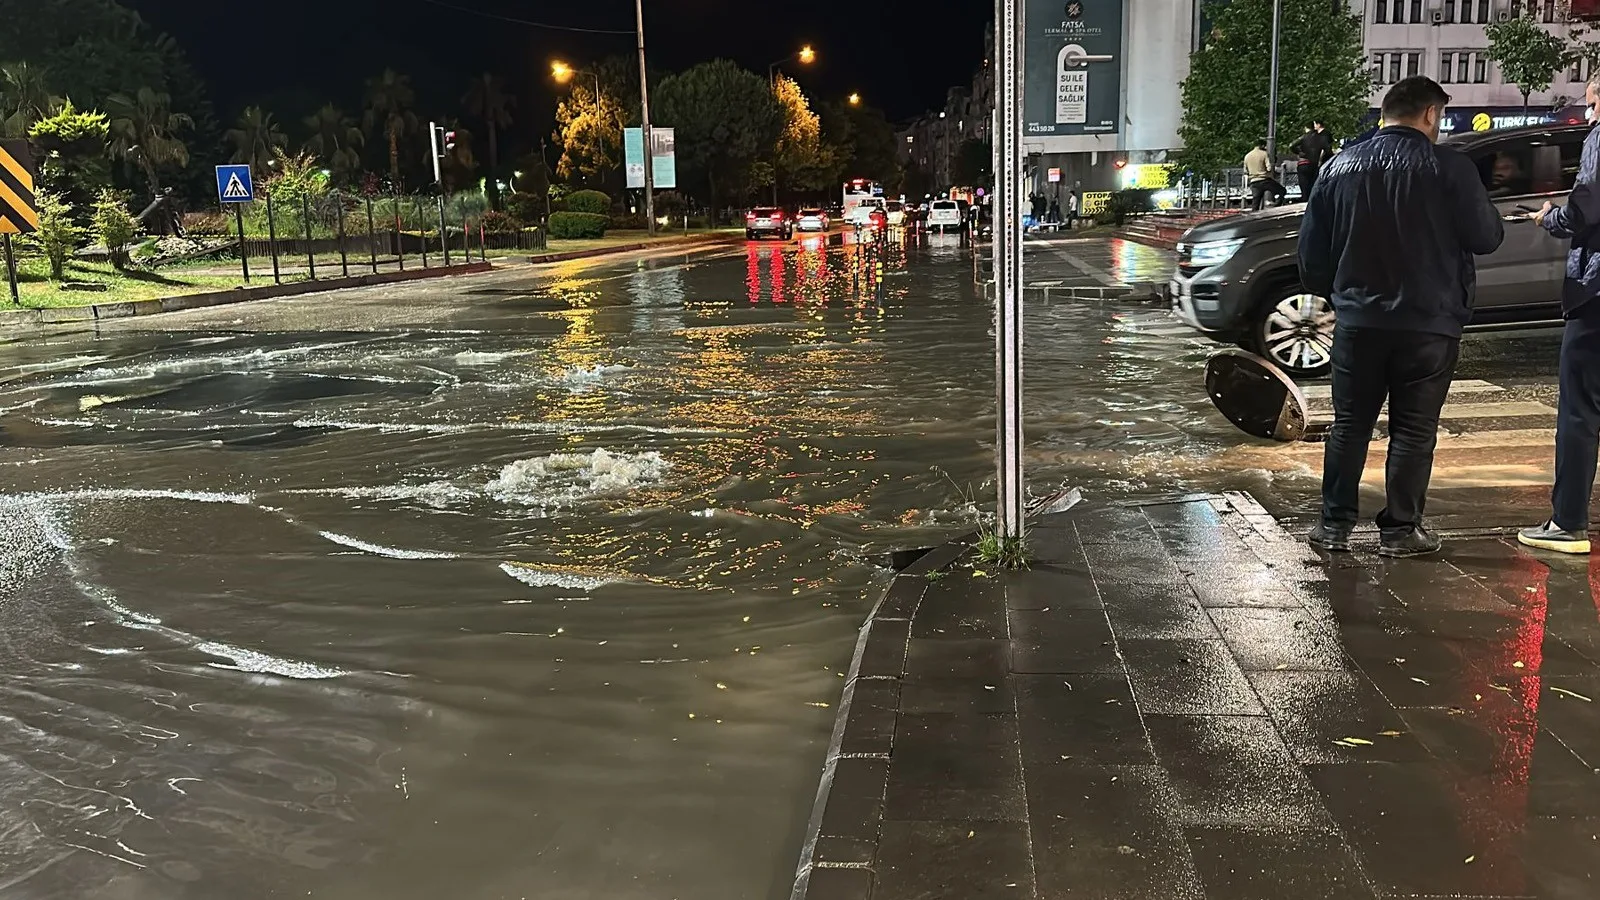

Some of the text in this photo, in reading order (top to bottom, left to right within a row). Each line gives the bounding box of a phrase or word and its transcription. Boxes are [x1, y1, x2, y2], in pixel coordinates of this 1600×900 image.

[1061, 74, 1071, 82] SU
[1060, 85, 1084, 93] GELEN
[1058, 94, 1085, 103] SAĞLIK
